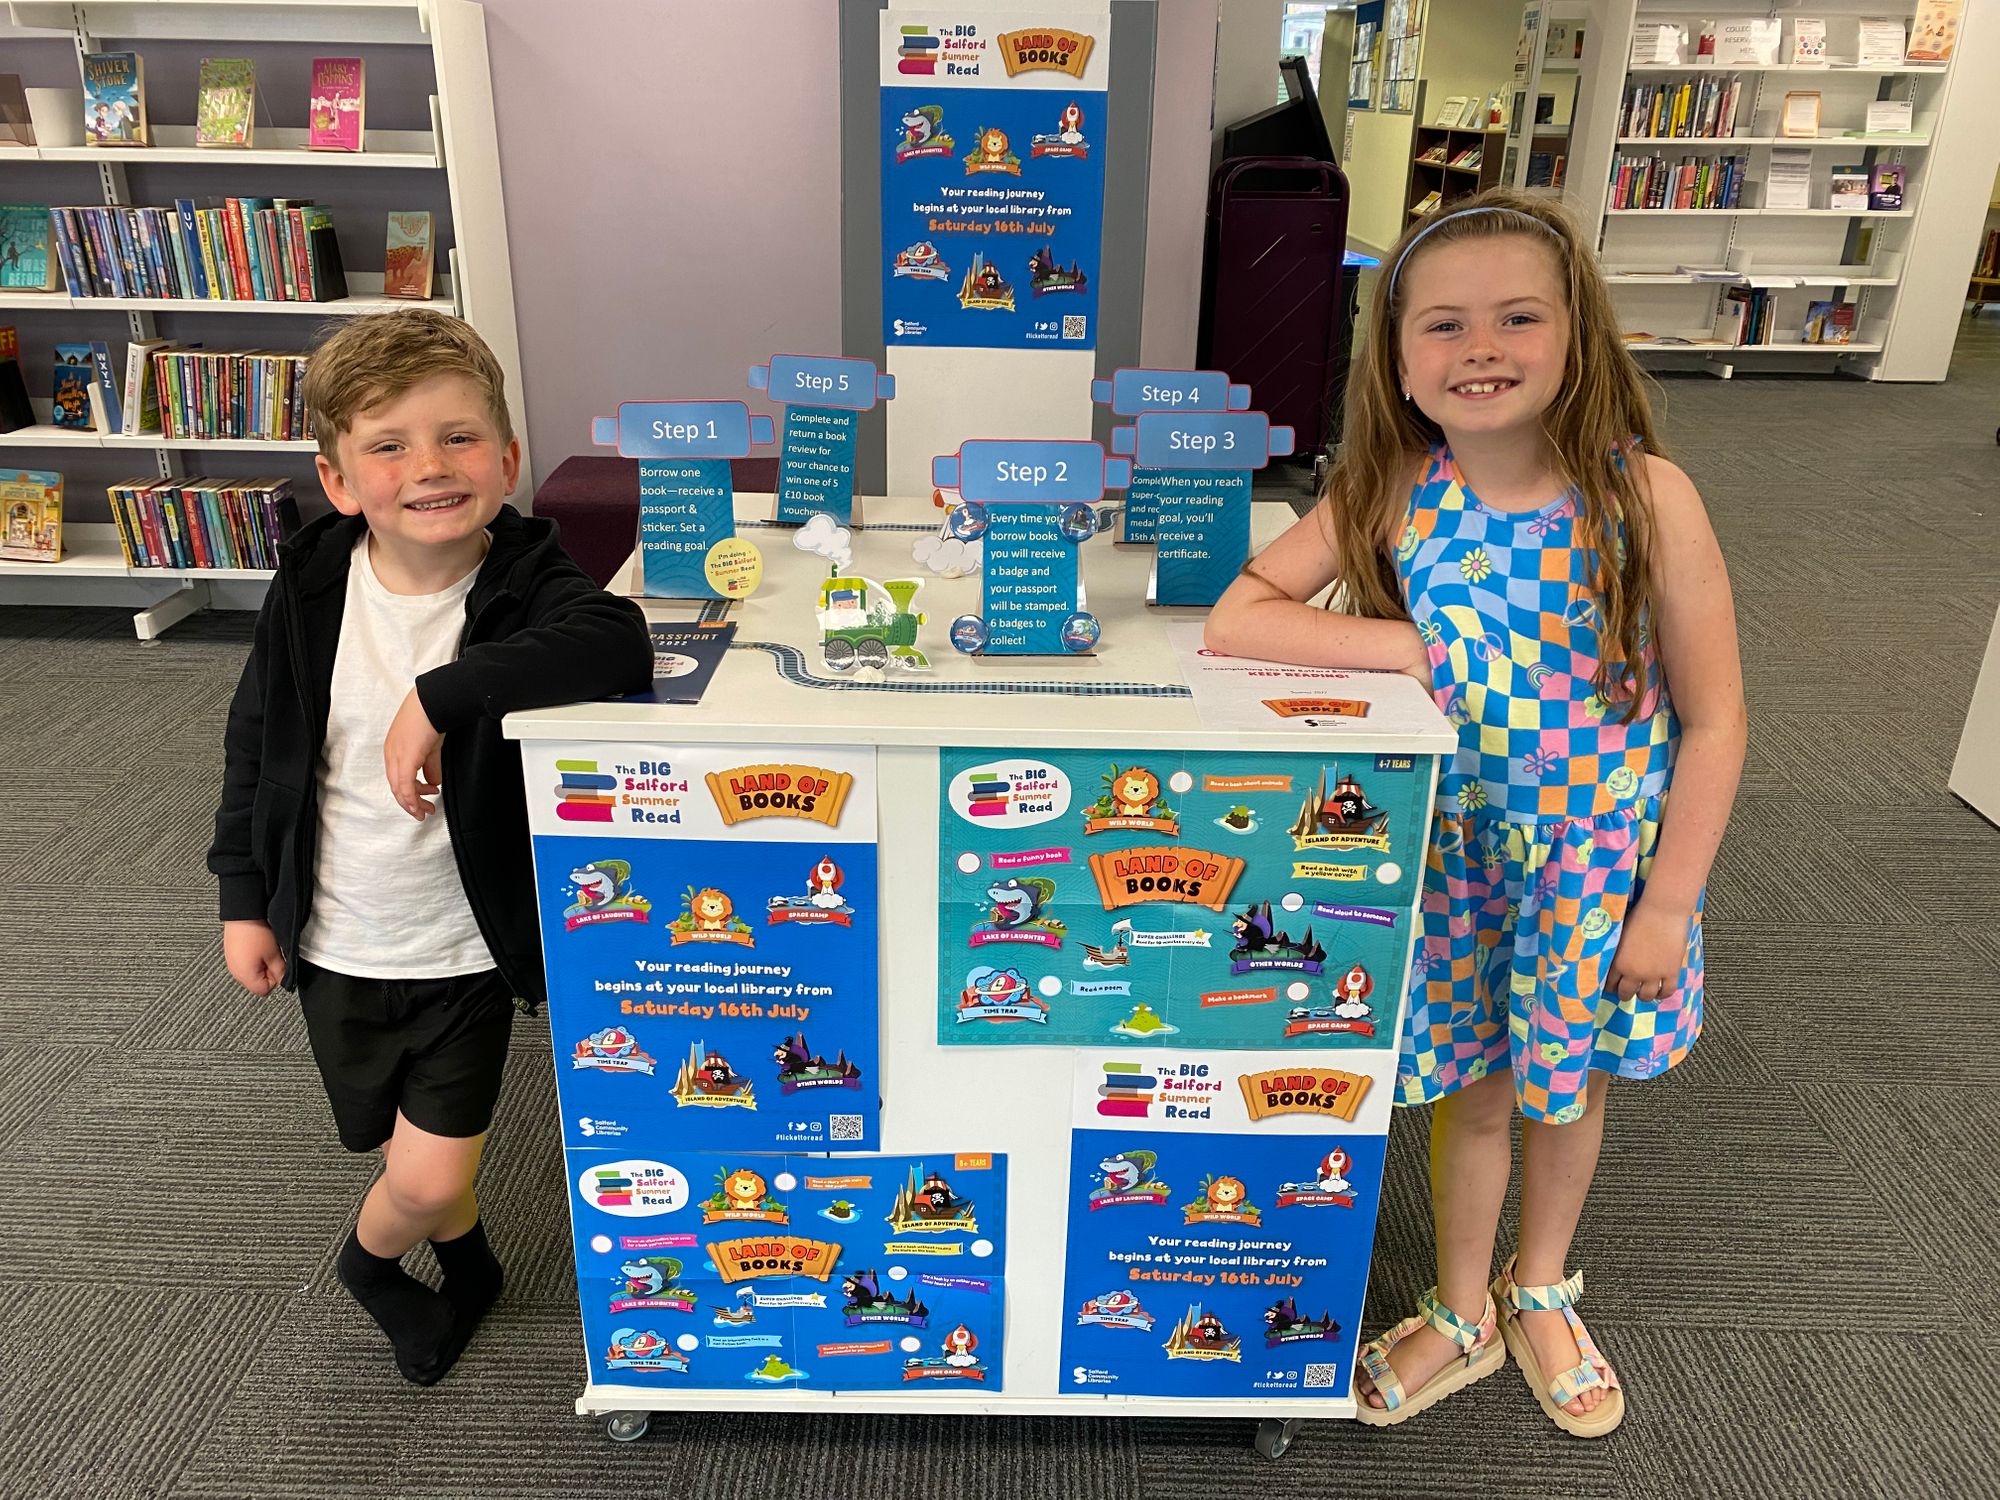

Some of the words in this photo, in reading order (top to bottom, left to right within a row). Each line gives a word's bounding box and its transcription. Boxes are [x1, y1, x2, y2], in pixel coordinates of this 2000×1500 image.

[955, 25, 976, 37] BIG
[945, 39, 986, 49] Salford
[1014, 35, 1053, 51] LAND
[1058, 37, 1078, 53] OF
[941, 52, 979, 61] Summer
[1019, 50, 1069, 66] BOOKS
[87, 60, 130, 81] SHIVER
[323, 64, 348, 74] MARY
[947, 63, 979, 75] Read
[318, 73, 354, 87] POPPINS
[929, 219, 992, 234] Saturday
[995, 220, 1023, 232] 16th
[1027, 222, 1055, 235] July
[9, 273, 46, 285] BEFORE
[796, 372, 832, 392] Step
[839, 375, 849, 390] 5
[1142, 385, 1182, 405] Step
[1187, 388, 1200, 403] 4
[790, 413, 831, 426] Complete
[833, 416, 849, 426] and
[652, 420, 699, 443] Step
[707, 420, 718, 438] 1
[790, 429, 816, 439] return
[826, 431, 846, 441] book
[1170, 431, 1216, 453] Step
[1223, 432, 1235, 449] 3
[788, 445, 816, 454] review
[819, 446, 831, 456] for
[641, 468, 678, 476] Borrow
[682, 469, 700, 477] one
[787, 462, 806, 472] your
[809, 462, 838, 472] chance
[840, 464, 849, 472] to
[997, 461, 1047, 485] Step
[1055, 462, 1068, 481] 2
[786, 477, 802, 485] win
[804, 478, 820, 486] one
[822, 478, 831, 486] of
[833, 479, 838, 487] 5
[1160, 477, 1190, 487] When
[1194, 480, 1212, 490] you
[1215, 477, 1243, 487] reach
[718, 488, 723, 496] a
[785, 491, 801, 499] £10
[804, 492, 824, 502] book
[1160, 497, 1182, 508] your
[1185, 495, 1223, 508] reading
[642, 504, 686, 516] passport
[690, 504, 697, 514] &
[991, 513, 1017, 526] Every
[1020, 513, 1044, 524] time
[1160, 513, 1184, 527] goal,
[642, 522, 677, 532] sticker.
[680, 523, 696, 532] Set
[991, 531, 1025, 541] borrow
[1029, 530, 1057, 541] books
[1159, 531, 1194, 541] receive
[644, 541, 682, 551] reading
[685, 541, 708, 552] goal.
[991, 549, 1009, 561] you
[1012, 548, 1028, 558] will
[1032, 548, 1065, 559] receive
[1159, 548, 1210, 560] certificate.
[991, 568, 996, 576] a
[999, 566, 1028, 579] badge
[1031, 566, 1049, 576] and
[991, 585, 1013, 596] your
[1016, 584, 1056, 596] passport
[991, 601, 1007, 610] will
[1011, 601, 1021, 610] be
[1024, 601, 1069, 613] stamped.
[991, 619, 996, 628] 6
[1000, 618, 1033, 631] badges
[1036, 619, 1046, 628] to
[991, 635, 1026, 645] collect!
[615, 765, 635, 775] The
[640, 762, 671, 775] BIG
[1379, 760, 1390, 768] 4-7
[1392, 760, 1411, 768] YEARS
[625, 778, 688, 792] Salford
[730, 773, 791, 795] LAND
[797, 776, 828, 796] OF
[622, 795, 679, 806] Summer
[740, 793, 816, 812] BOOKS
[632, 809, 680, 824] Read
[1305, 837, 1329, 845] ISLAND
[1341, 837, 1380, 845] ADVENTURE
[1024, 853, 1044, 862] funny
[1115, 856, 1179, 877] LAND
[1185, 859, 1219, 880] OF
[1126, 877, 1202, 897] BOOKS
[576, 916, 590, 924] LAKE
[601, 912, 634, 920] LAUGHTER
[635, 961, 671, 972] Your
[675, 963, 732, 976] reading
[734, 964, 791, 977] journey
[595, 980, 642, 994] begins
[646, 982, 663, 992] at
[667, 983, 701, 994] your
[705, 982, 738, 994] local
[742, 984, 792, 997] library
[796, 985, 832, 996] from
[621, 1000, 714, 1019] Saturday
[719, 1002, 762, 1017] 16th
[767, 1005, 809, 1021] July
[970, 1159, 986, 1167] YEARS
[1129, 1268, 1216, 1286] Saturday
[1221, 1271, 1260, 1285] 16th
[1264, 1273, 1302, 1287] July
